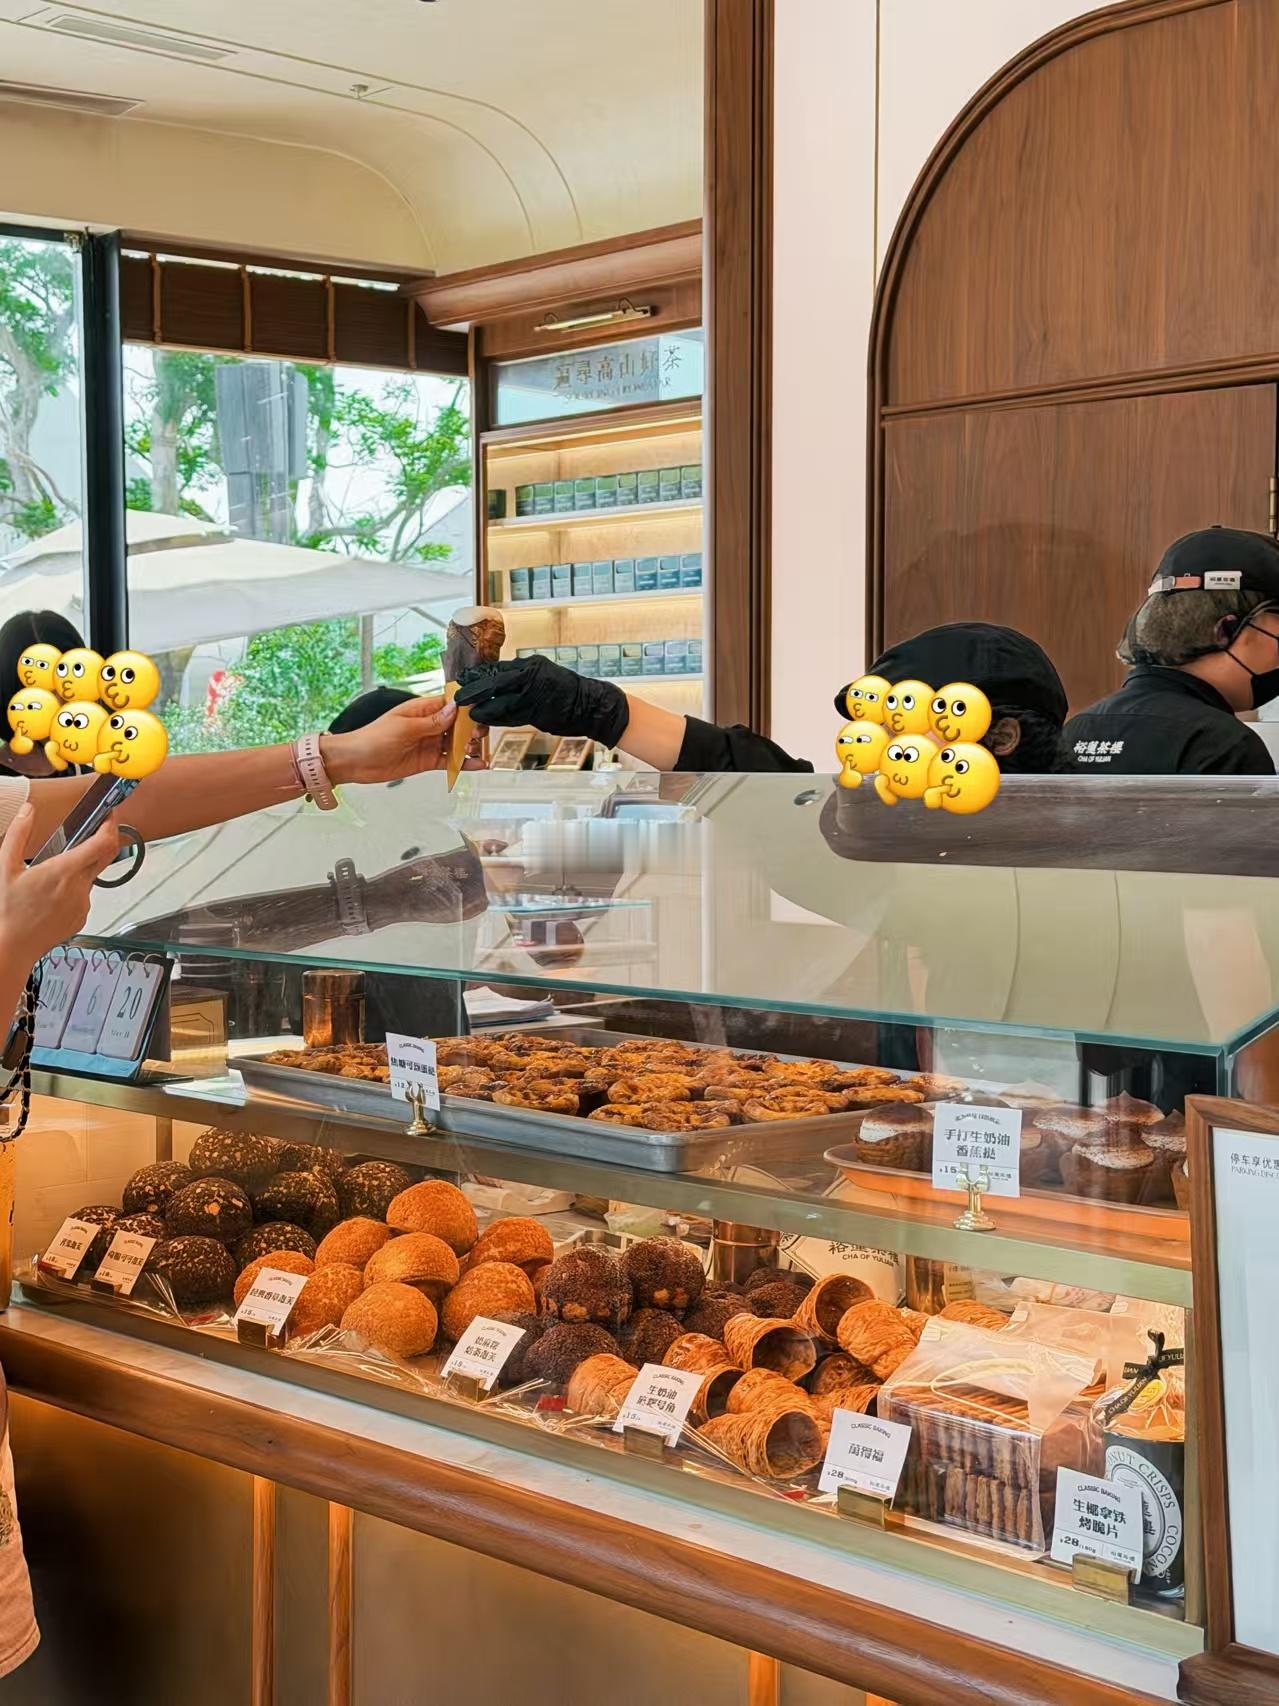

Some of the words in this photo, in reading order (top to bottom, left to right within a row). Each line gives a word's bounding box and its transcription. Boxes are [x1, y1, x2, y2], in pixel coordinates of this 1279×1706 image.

[117, 986, 143, 1020] 20
[944, 1129, 1010, 1146] 手打生奶油
[956, 1145, 996, 1160] 香蕉挞
[647, 1384, 678, 1400] 生奶油
[851, 1422, 872, 1430] CLASSIC
[1138, 1463, 1176, 1510] CRISPS
[1073, 1498, 1127, 1525] 生椰拿铁
[1078, 1515, 1120, 1539] 烤脆片
